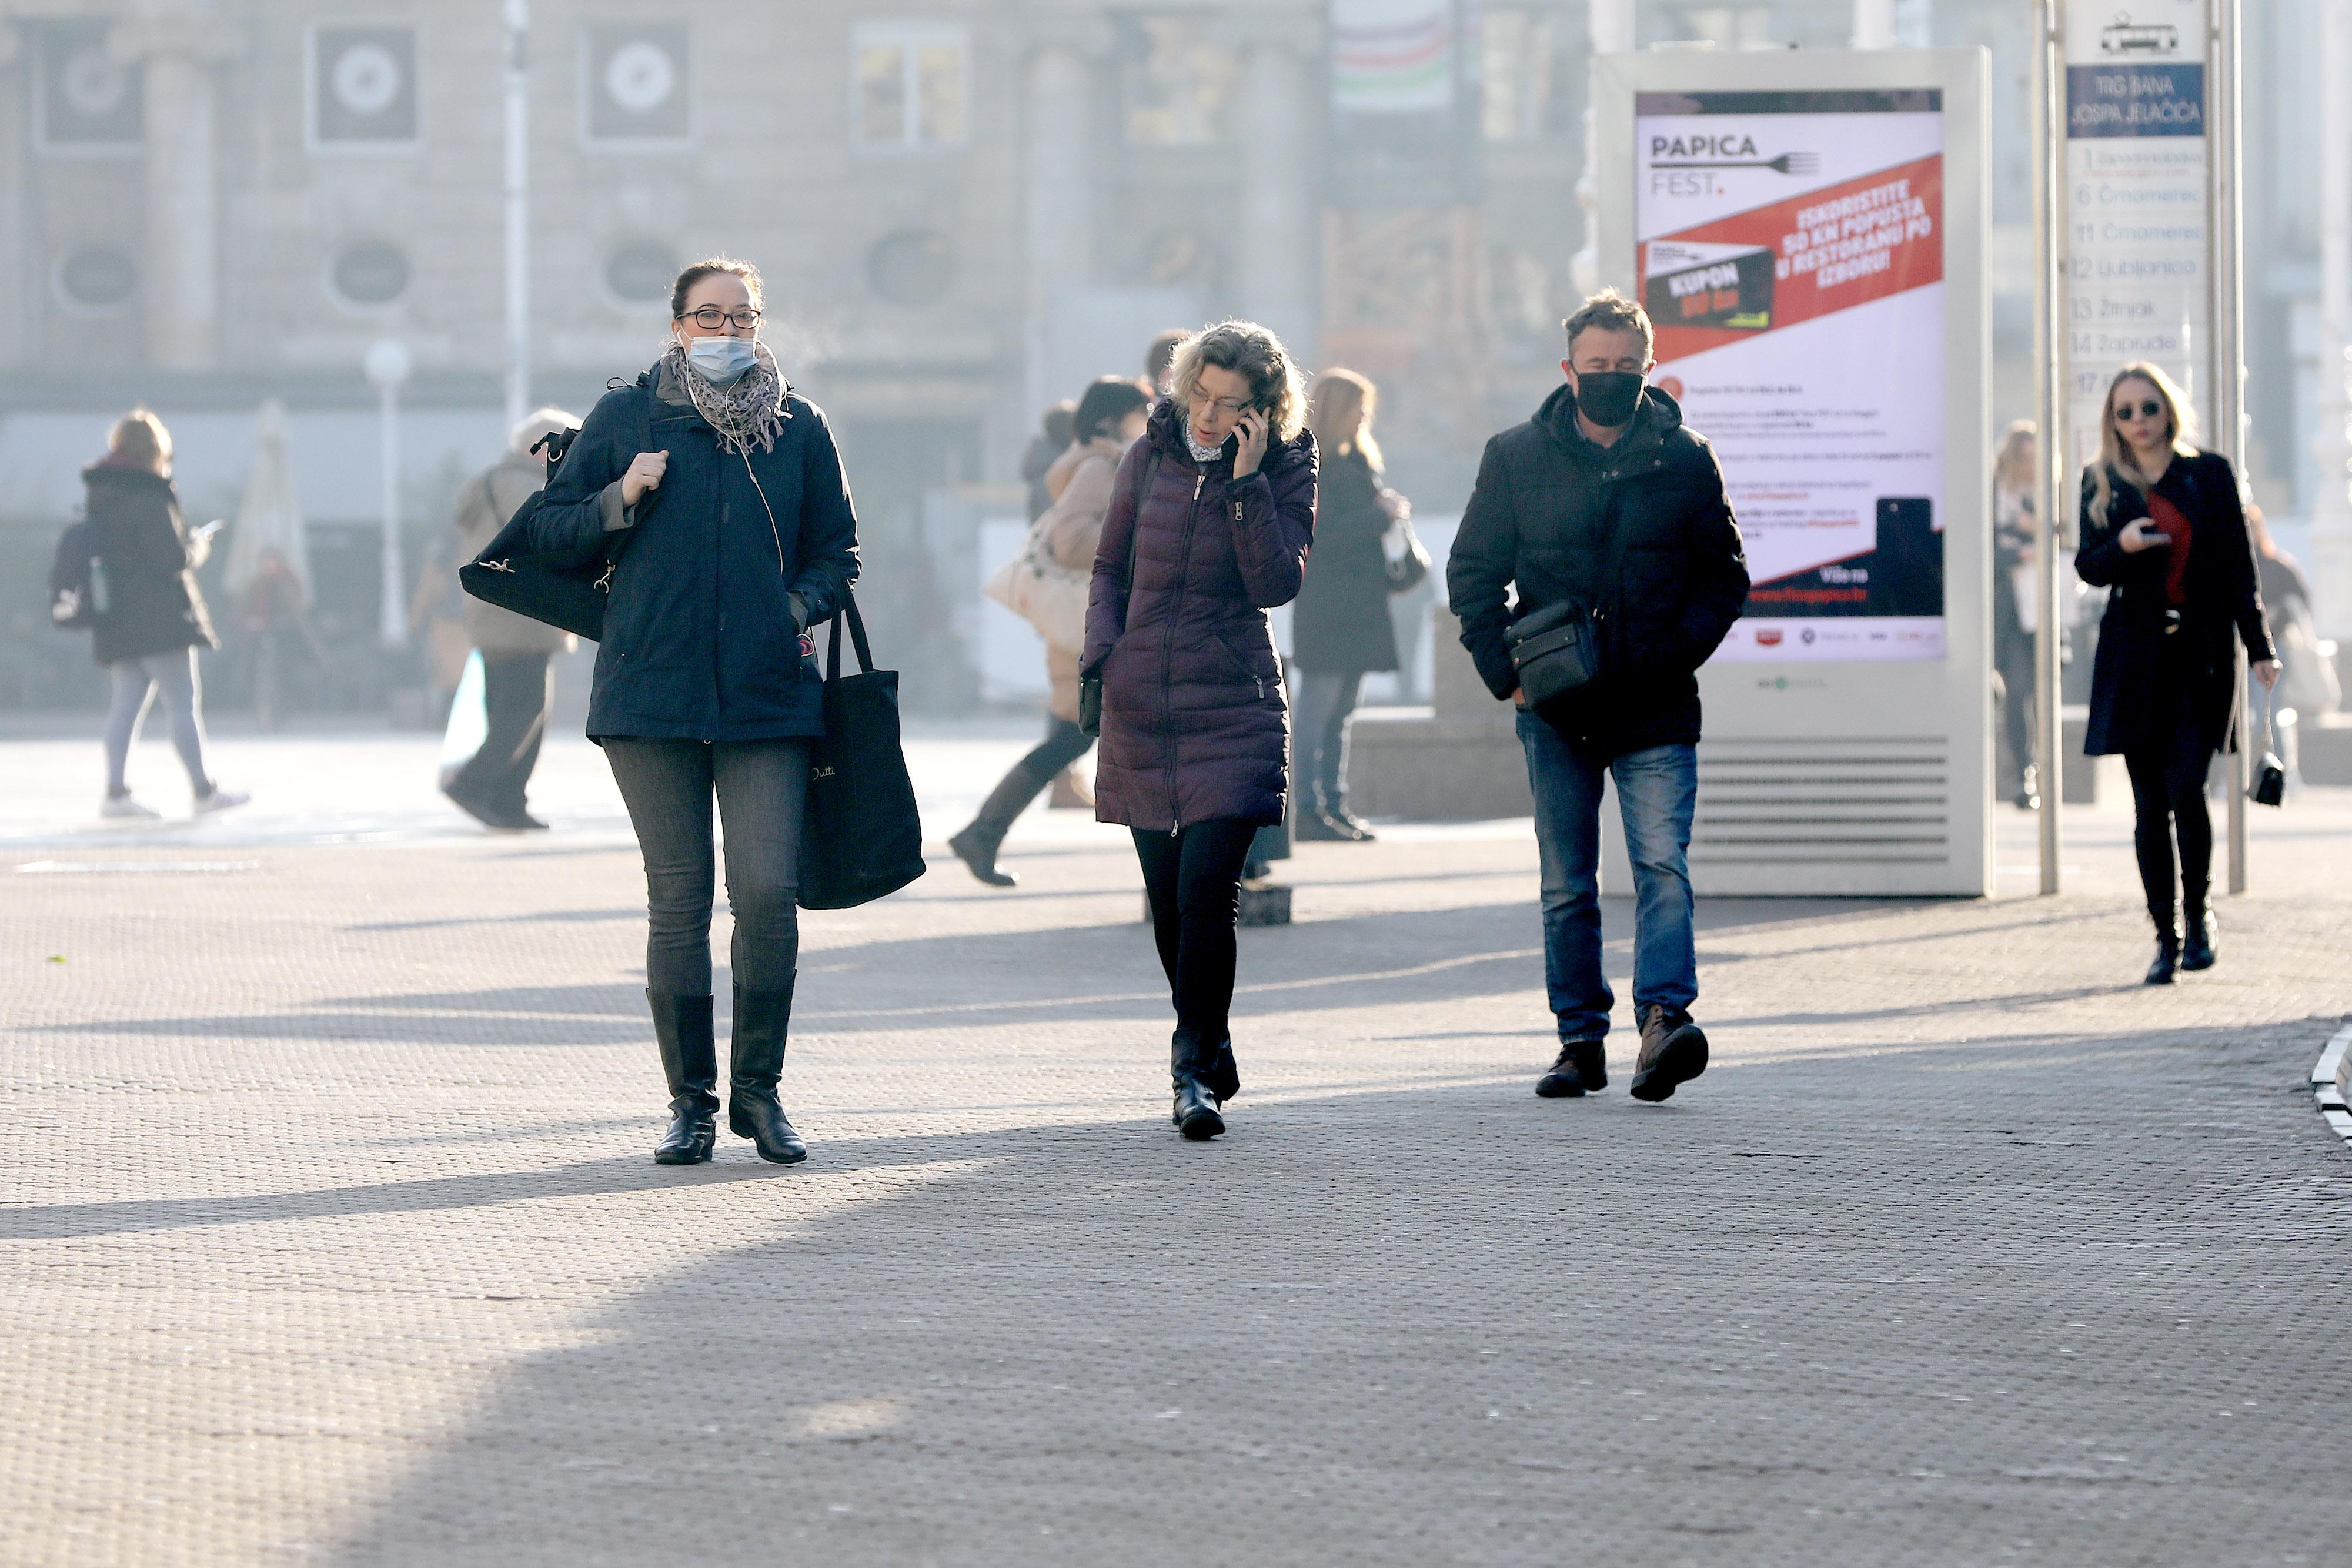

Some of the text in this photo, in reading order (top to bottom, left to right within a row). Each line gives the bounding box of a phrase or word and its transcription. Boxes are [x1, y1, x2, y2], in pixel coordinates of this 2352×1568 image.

[2096, 75, 2174, 98] TRG BANA
[1652, 135, 1758, 156] PAPICA
[1651, 172, 1725, 196] FEST.
[2076, 183, 2091, 206] 6
[1906, 215, 1933, 240] PO
[2070, 256, 2093, 279] 12
[1668, 262, 1740, 298] KUPON
[2070, 297, 2093, 320] 13
